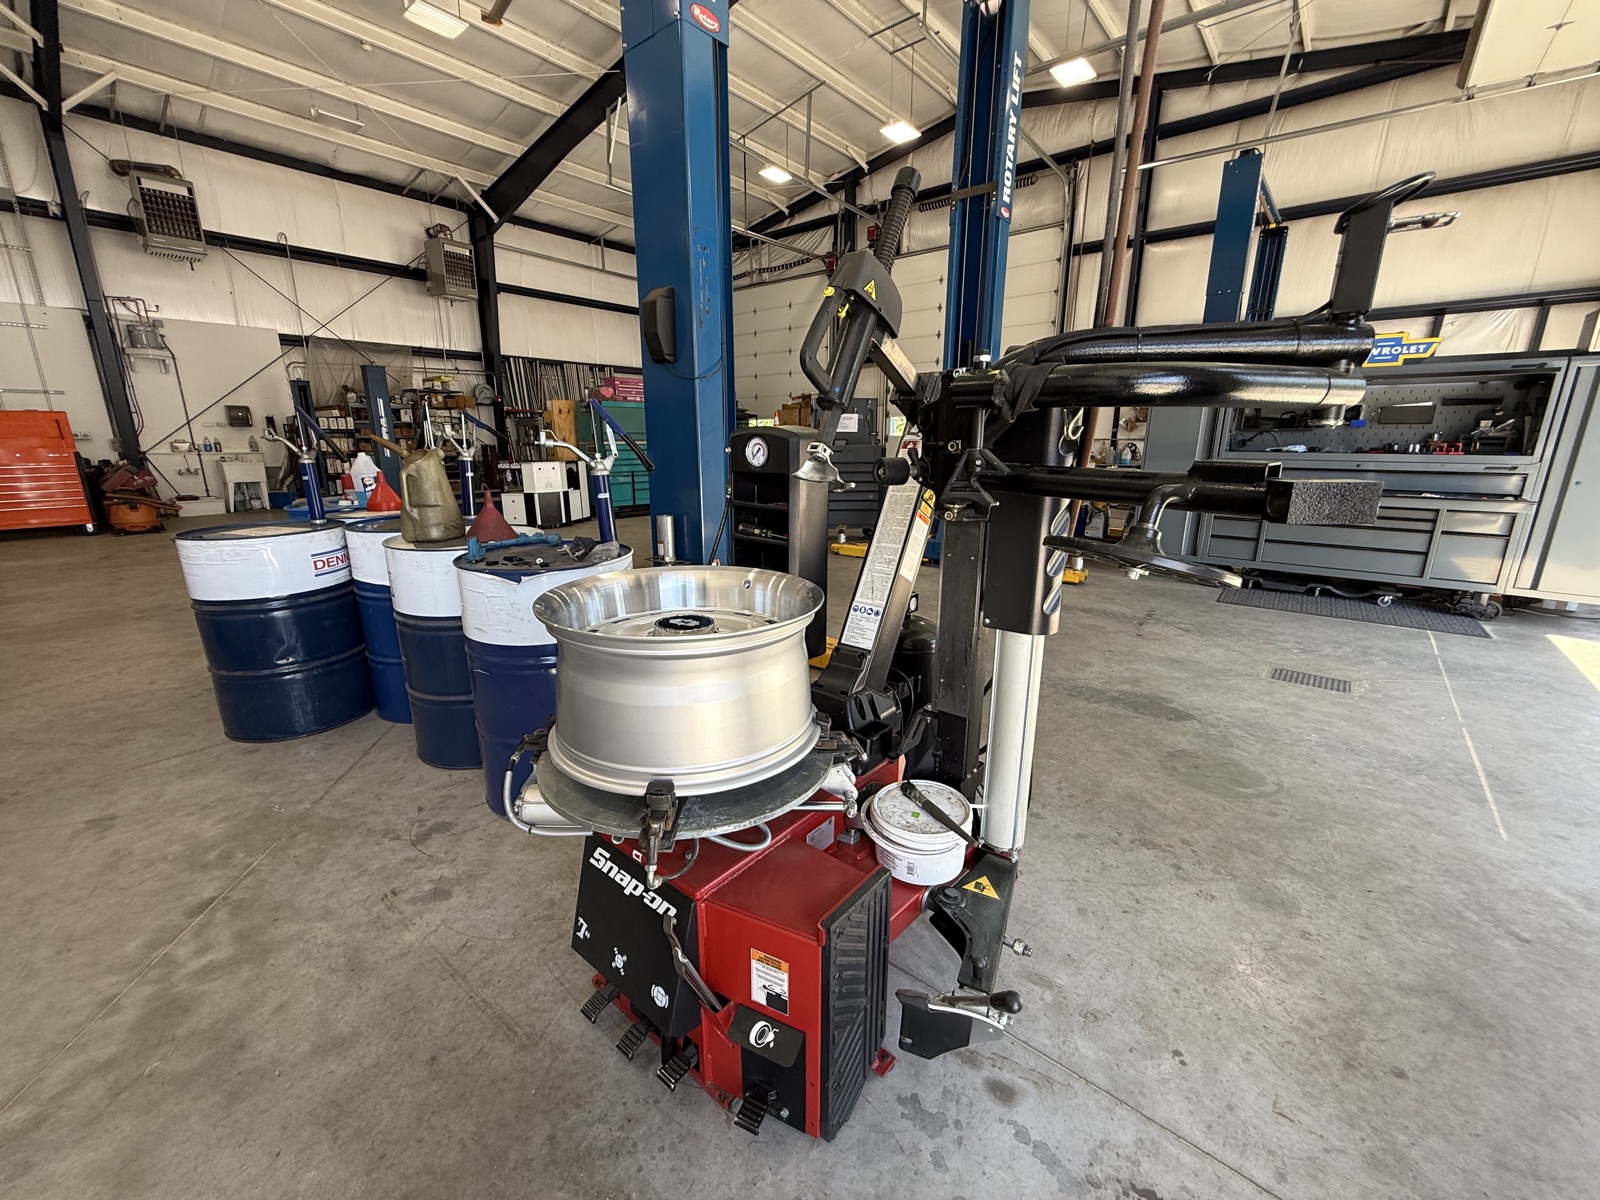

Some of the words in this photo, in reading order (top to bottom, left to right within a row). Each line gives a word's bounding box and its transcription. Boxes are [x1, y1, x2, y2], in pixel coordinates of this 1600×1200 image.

[693, 4, 718, 29] Rotary
[1002, 108, 1018, 204] ROTARY
[1010, 51, 1023, 106] LIFT
[589, 847, 677, 917] Snap-on
